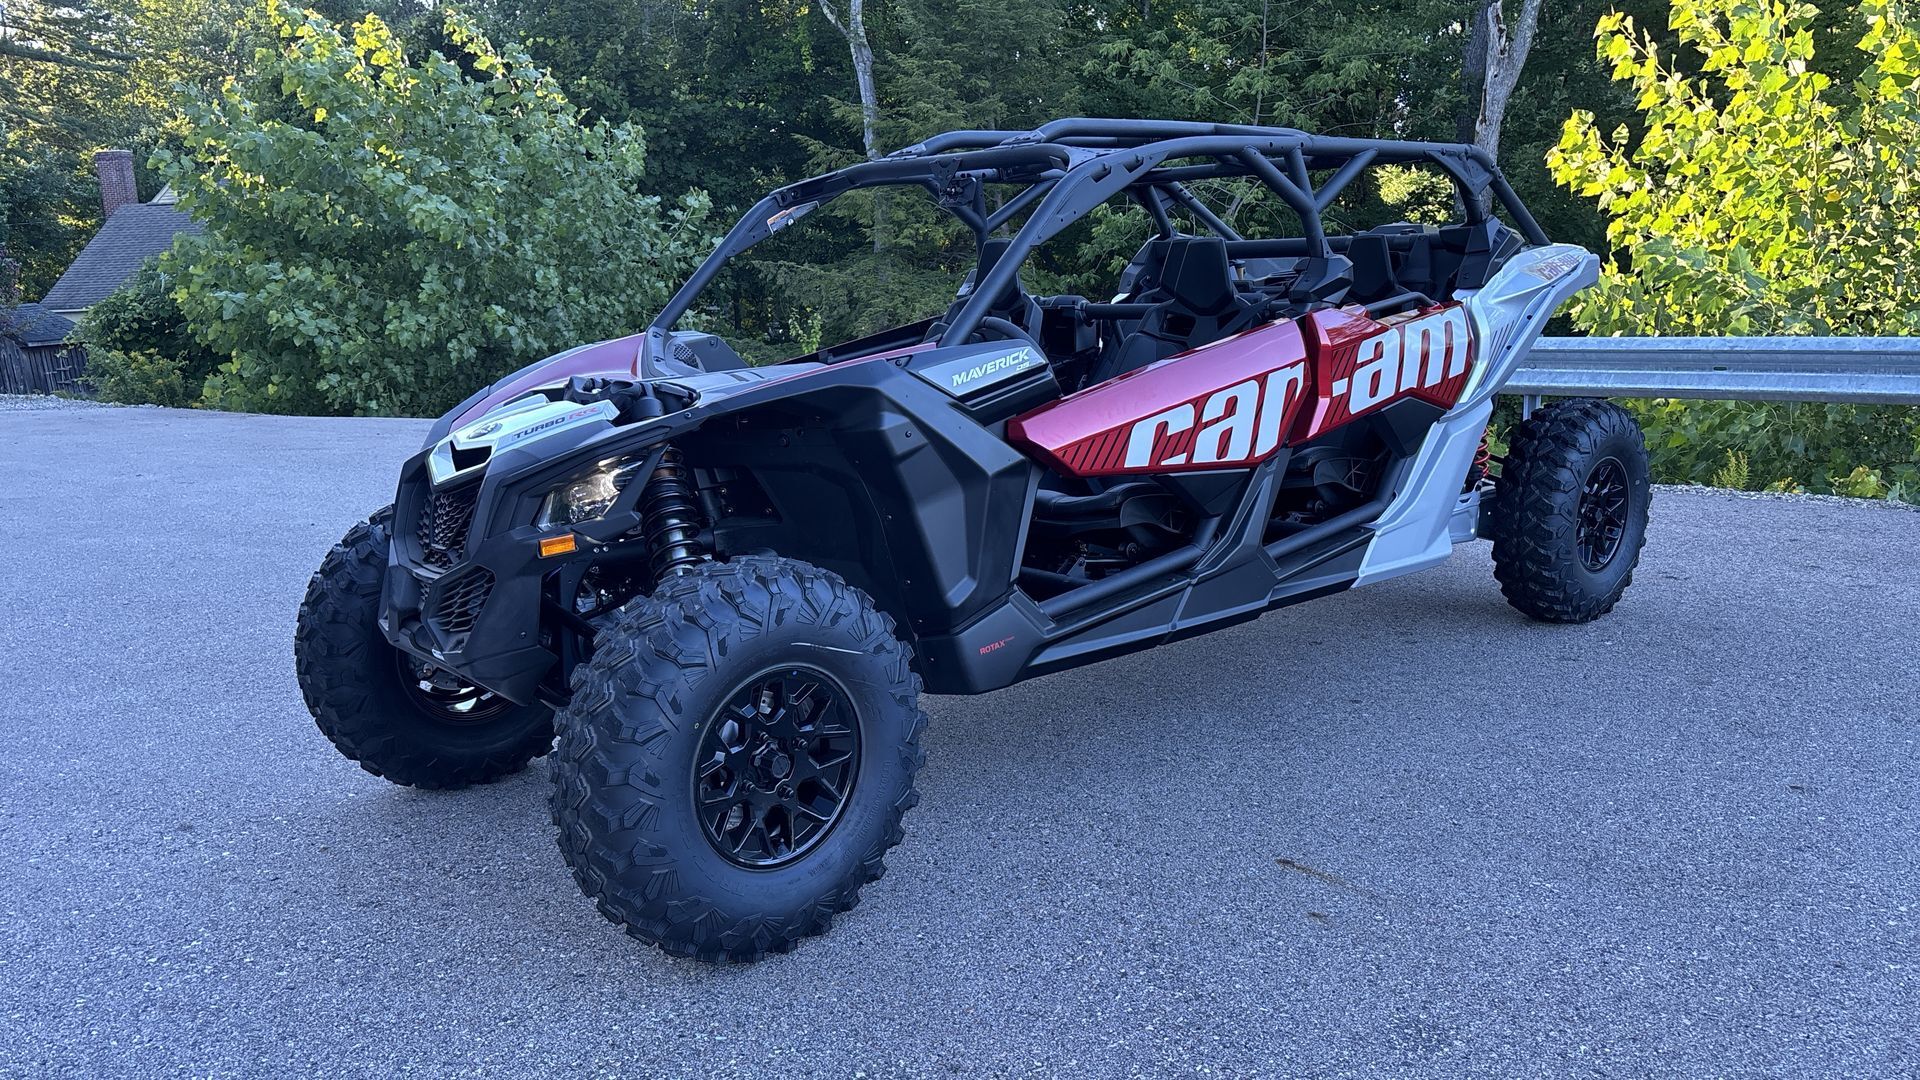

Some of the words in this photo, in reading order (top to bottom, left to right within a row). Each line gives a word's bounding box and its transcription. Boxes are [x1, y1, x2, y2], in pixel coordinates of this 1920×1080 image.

[952, 348, 1029, 386] MAVERICK
[513, 416, 566, 438] TURBO
[568, 406, 598, 420] RR
[979, 639, 1006, 655] ROTAX
